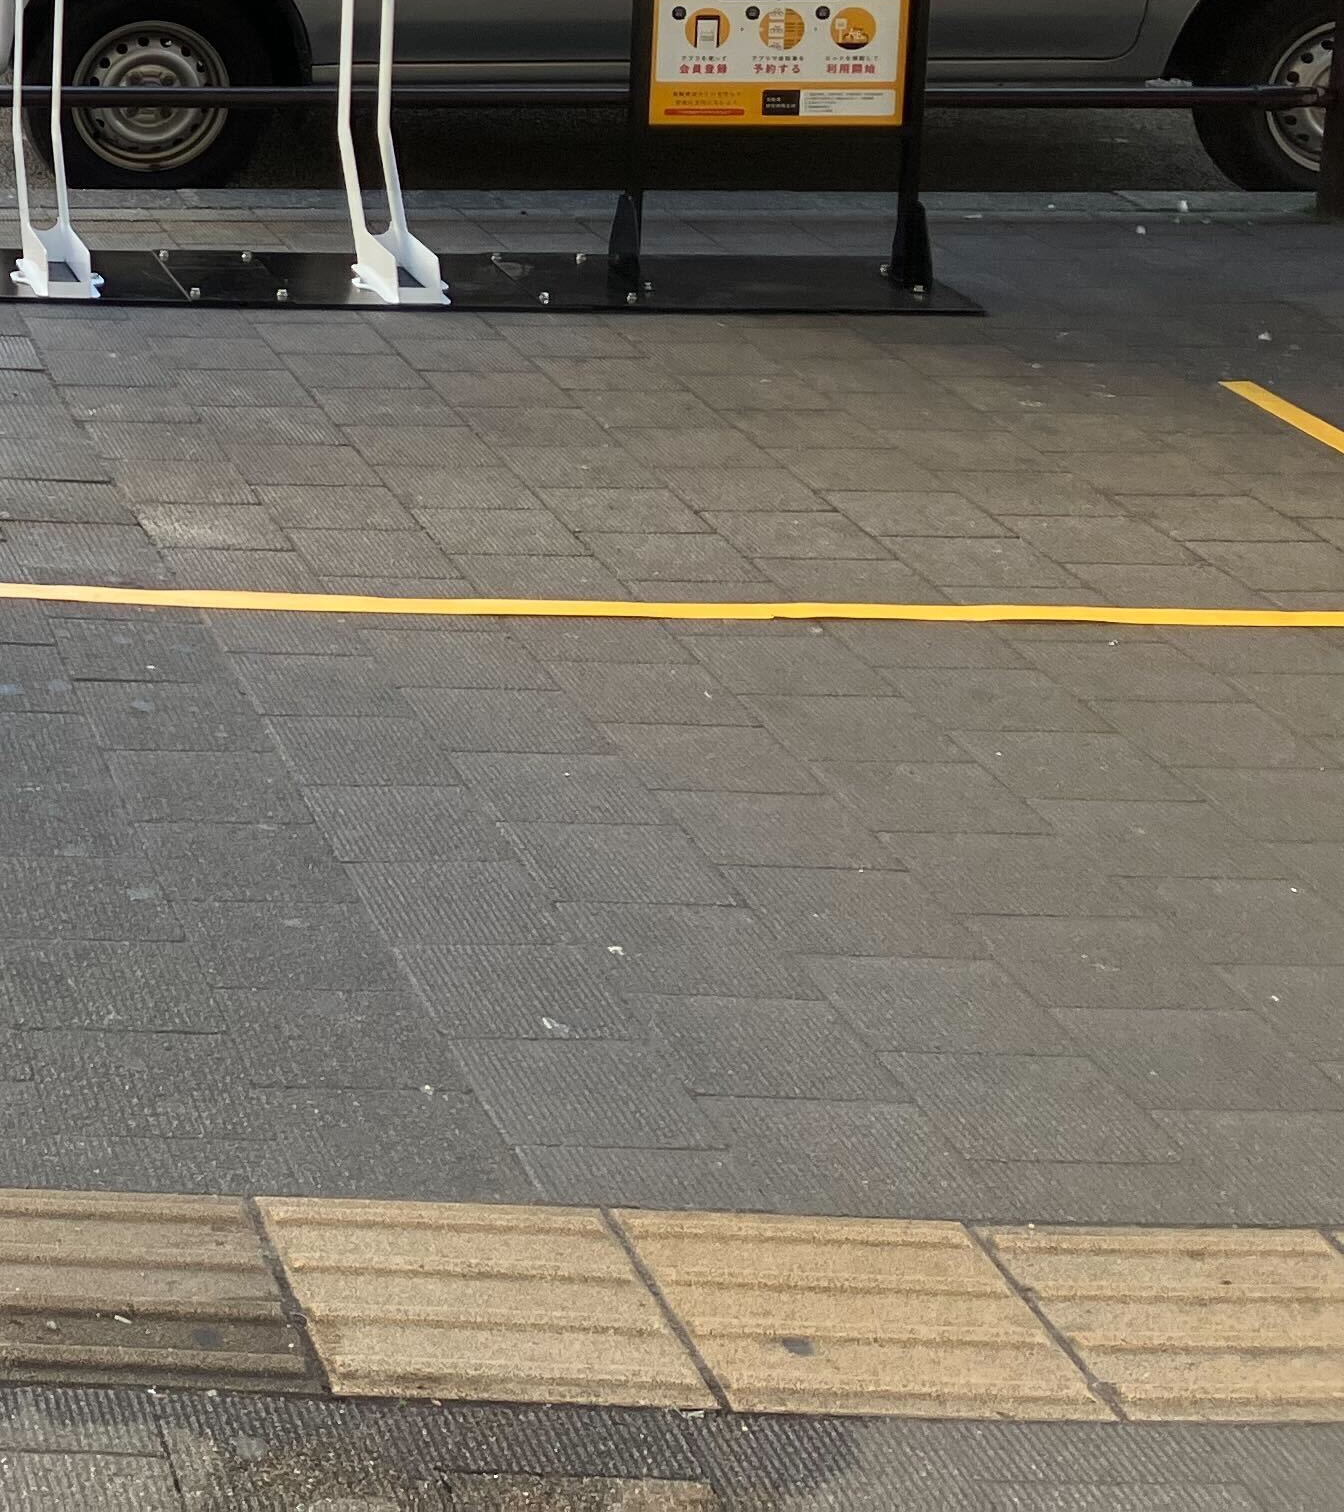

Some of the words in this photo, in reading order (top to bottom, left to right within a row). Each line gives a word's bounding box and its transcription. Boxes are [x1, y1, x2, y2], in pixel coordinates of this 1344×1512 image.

[679, 63, 728, 74] 会員登録
[753, 63, 802, 74] 予約する
[826, 63, 876, 74] 利用開始
